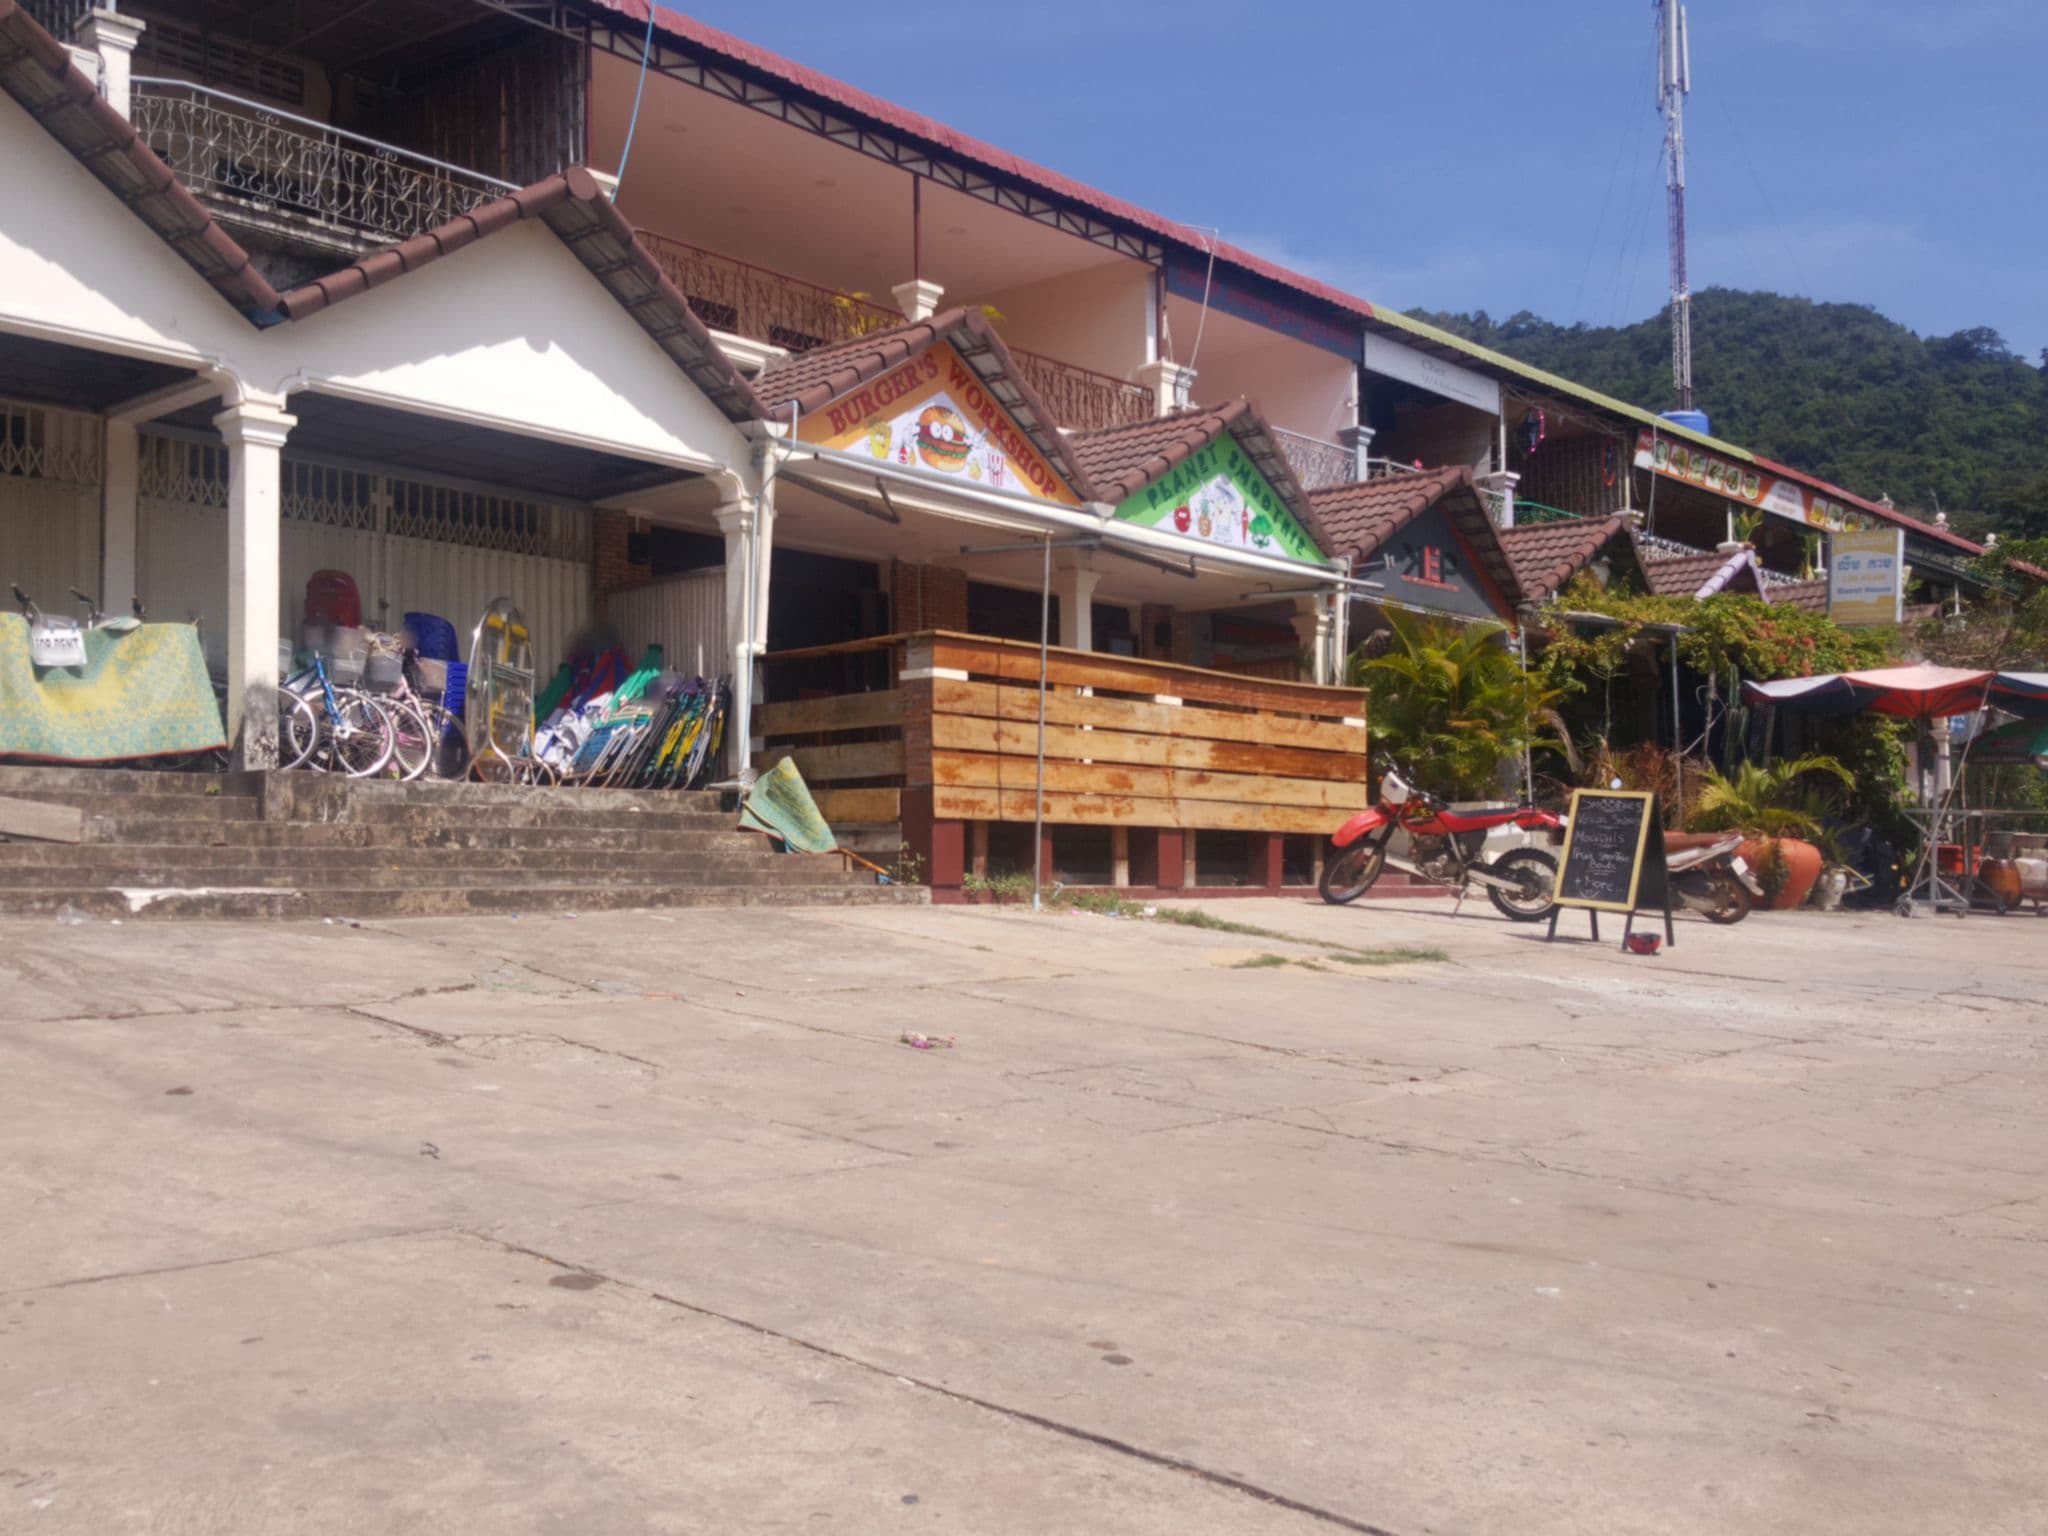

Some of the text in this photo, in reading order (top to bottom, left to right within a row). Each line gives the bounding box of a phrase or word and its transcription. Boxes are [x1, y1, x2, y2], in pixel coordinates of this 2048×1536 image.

[826, 352, 1058, 497] BURGER'S WORKSHOP
[1146, 442, 1306, 554] PLANET SMOOTHIE
